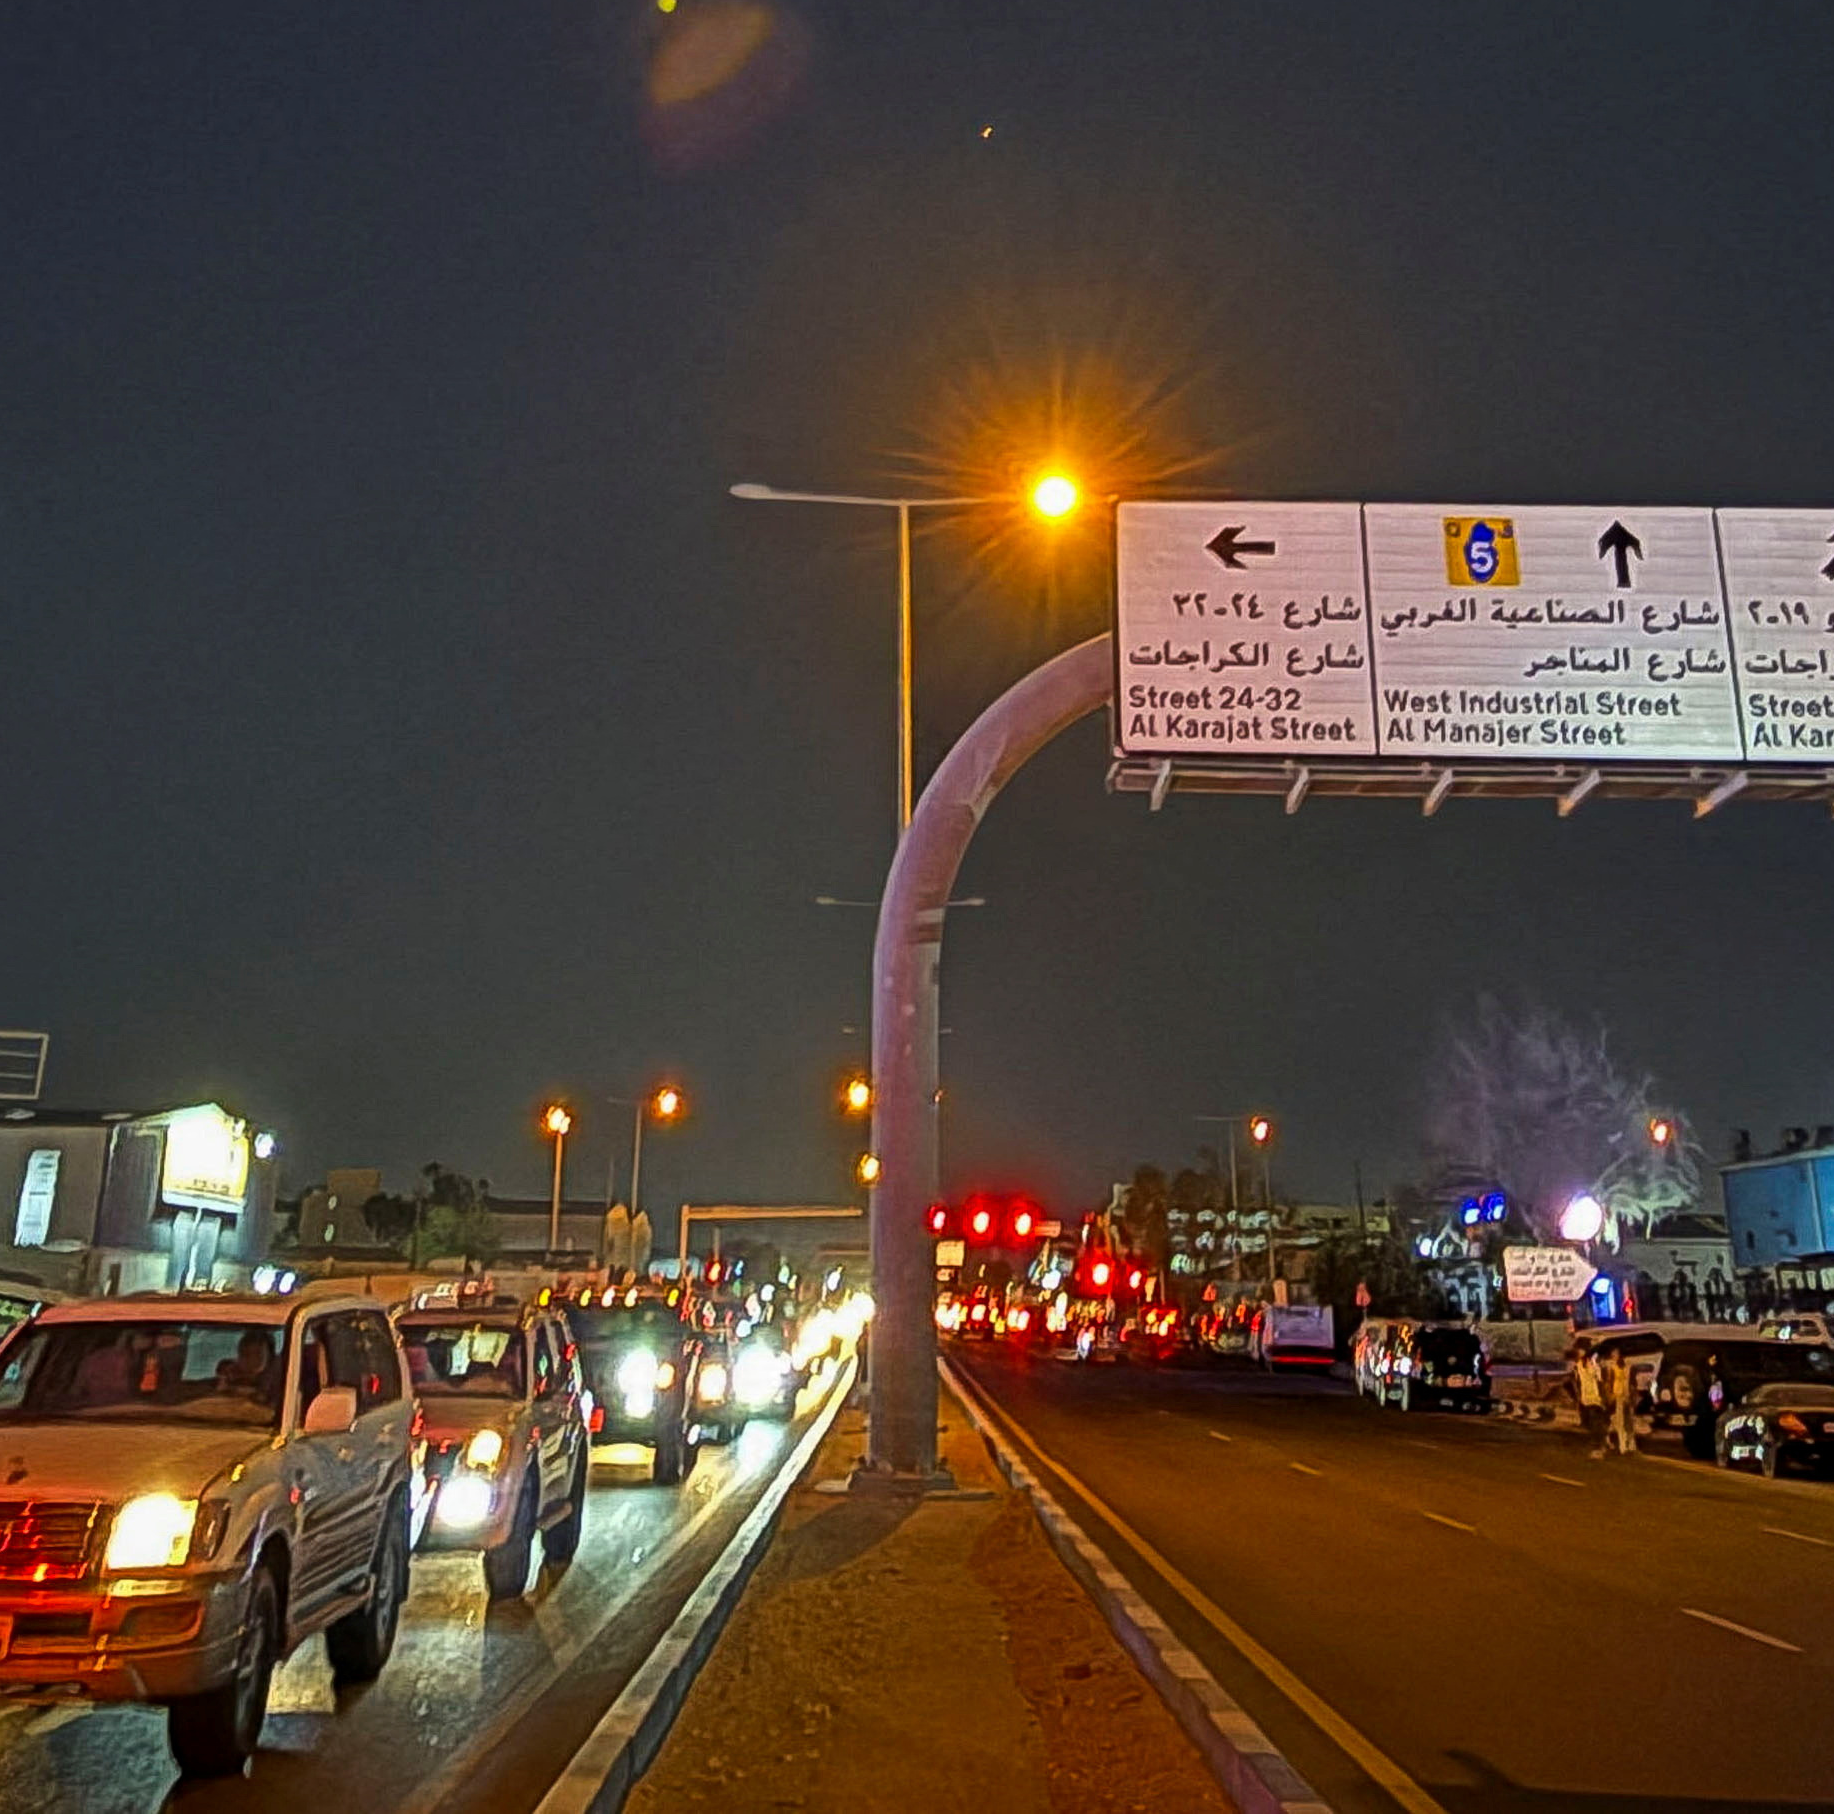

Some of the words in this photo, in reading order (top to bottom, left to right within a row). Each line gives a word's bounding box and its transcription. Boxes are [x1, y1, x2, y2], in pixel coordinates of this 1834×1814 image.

[1471, 541, 1494, 573] 5
[1283, 595, 1361, 629] شارع
[1381, 598, 1476, 637] الغربي
[1491, 599, 1624, 629] الصناعية
[1642, 600, 1719, 634] شارع
[1129, 640, 1269, 673] الكراجات
[1286, 643, 1364, 677] شارع
[1648, 648, 1726, 682] شارع
[1128, 685, 1212, 709] Street
[1219, 686, 1302, 711] 24-32
[1384, 689, 1452, 714] West
[1460, 691, 1589, 715] Industrial
[1597, 692, 1682, 716] Street
[1749, 694, 1834, 718] Street
[1129, 714, 1158, 738] Al
[1166, 714, 1263, 743] Karajat
[1270, 716, 1356, 741] Street
[1387, 718, 1416, 742] Al
[1424, 718, 1532, 747] Manajer
[1540, 719, 1626, 745] Street
[1753, 722, 1782, 747] Al
